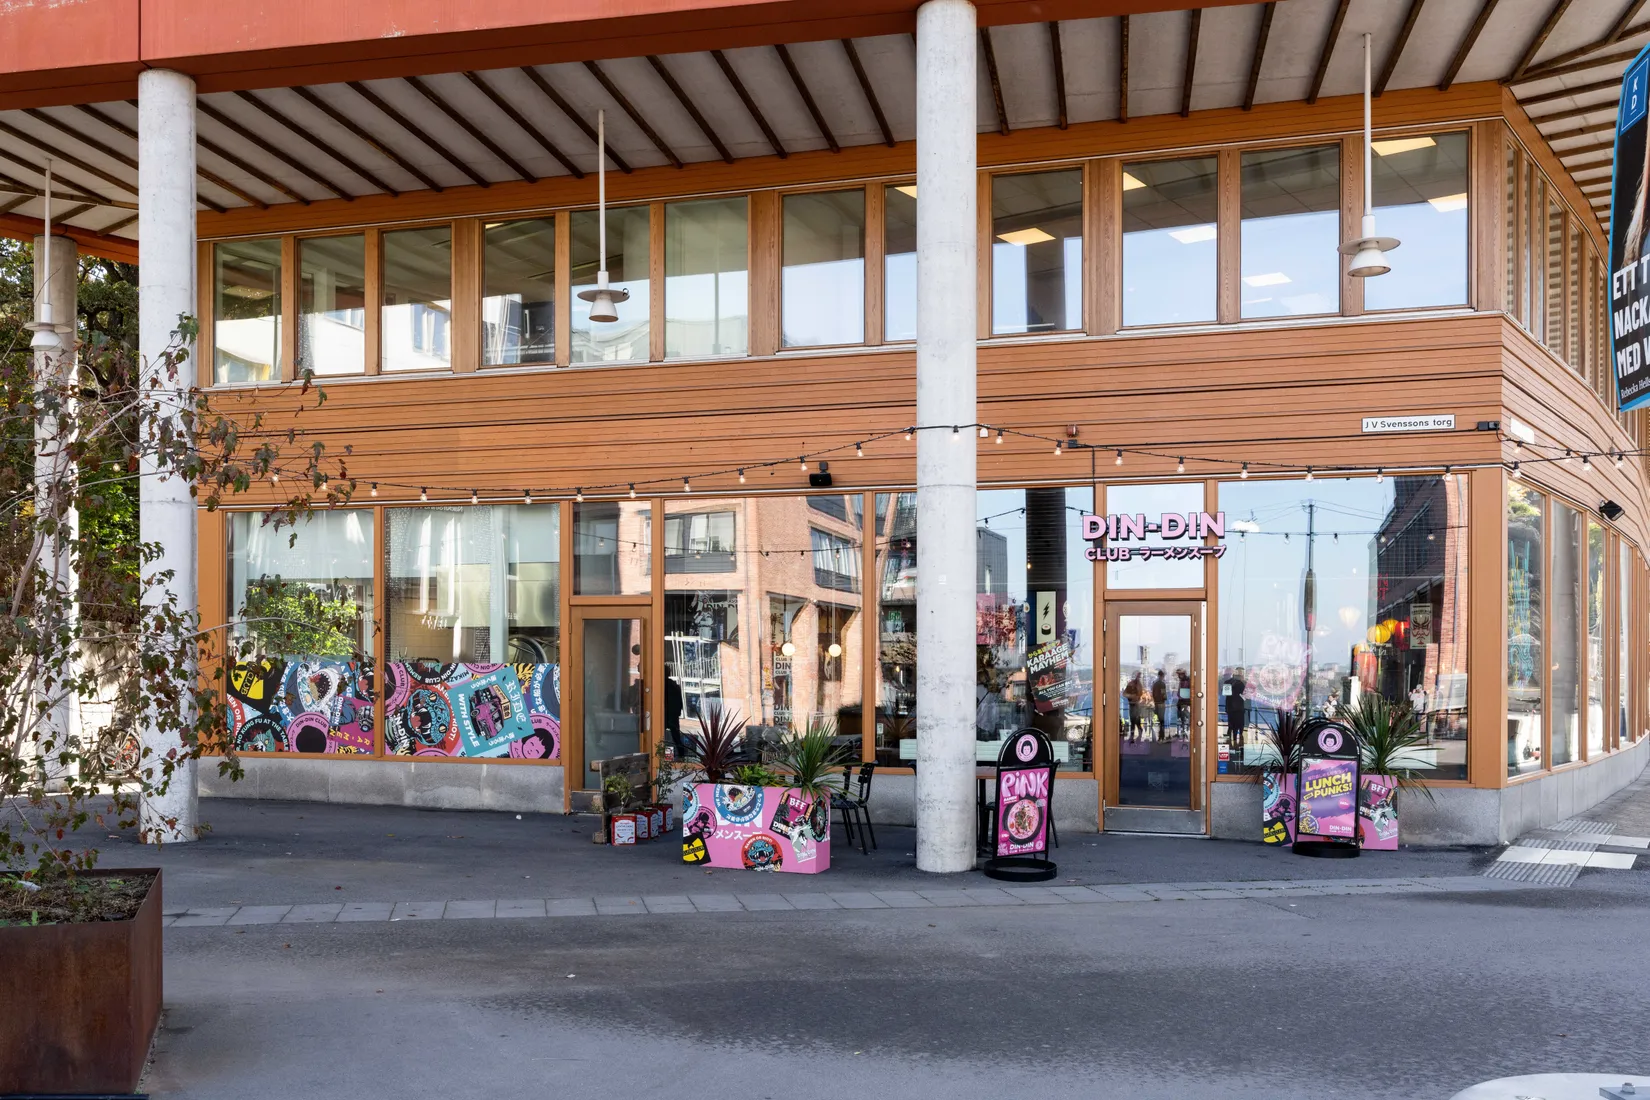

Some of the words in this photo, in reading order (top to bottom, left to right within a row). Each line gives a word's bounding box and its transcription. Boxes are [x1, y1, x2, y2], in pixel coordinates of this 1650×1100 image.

[1612, 260, 1638, 301] ETT
[1616, 342, 1641, 379] MED
[1380, 420, 1429, 428] Svenssons
[1433, 419, 1452, 427] torg
[1082, 511, 1226, 542] DIN-DIN
[1084, 547, 1132, 562] CLUB
[1139, 544, 1227, 562] ラーメンスープ
[1026, 642, 1068, 668] KARAAGE
[1030, 651, 1069, 674] MAYHEM
[504, 680, 526, 723] RIDE
[315, 718, 327, 728] CLUB
[458, 693, 468, 718] WITH
[463, 720, 480, 748] STYLE
[236, 736, 243, 746] NO
[242, 720, 254, 734] KUNG
[271, 721, 282, 732] THE
[280, 730, 289, 751] TABLE
[1305, 772, 1352, 792] LUNCH
[1314, 782, 1353, 798] PUNKS!
[789, 797, 806, 810] BFF
[744, 837, 756, 849] RAMEN
